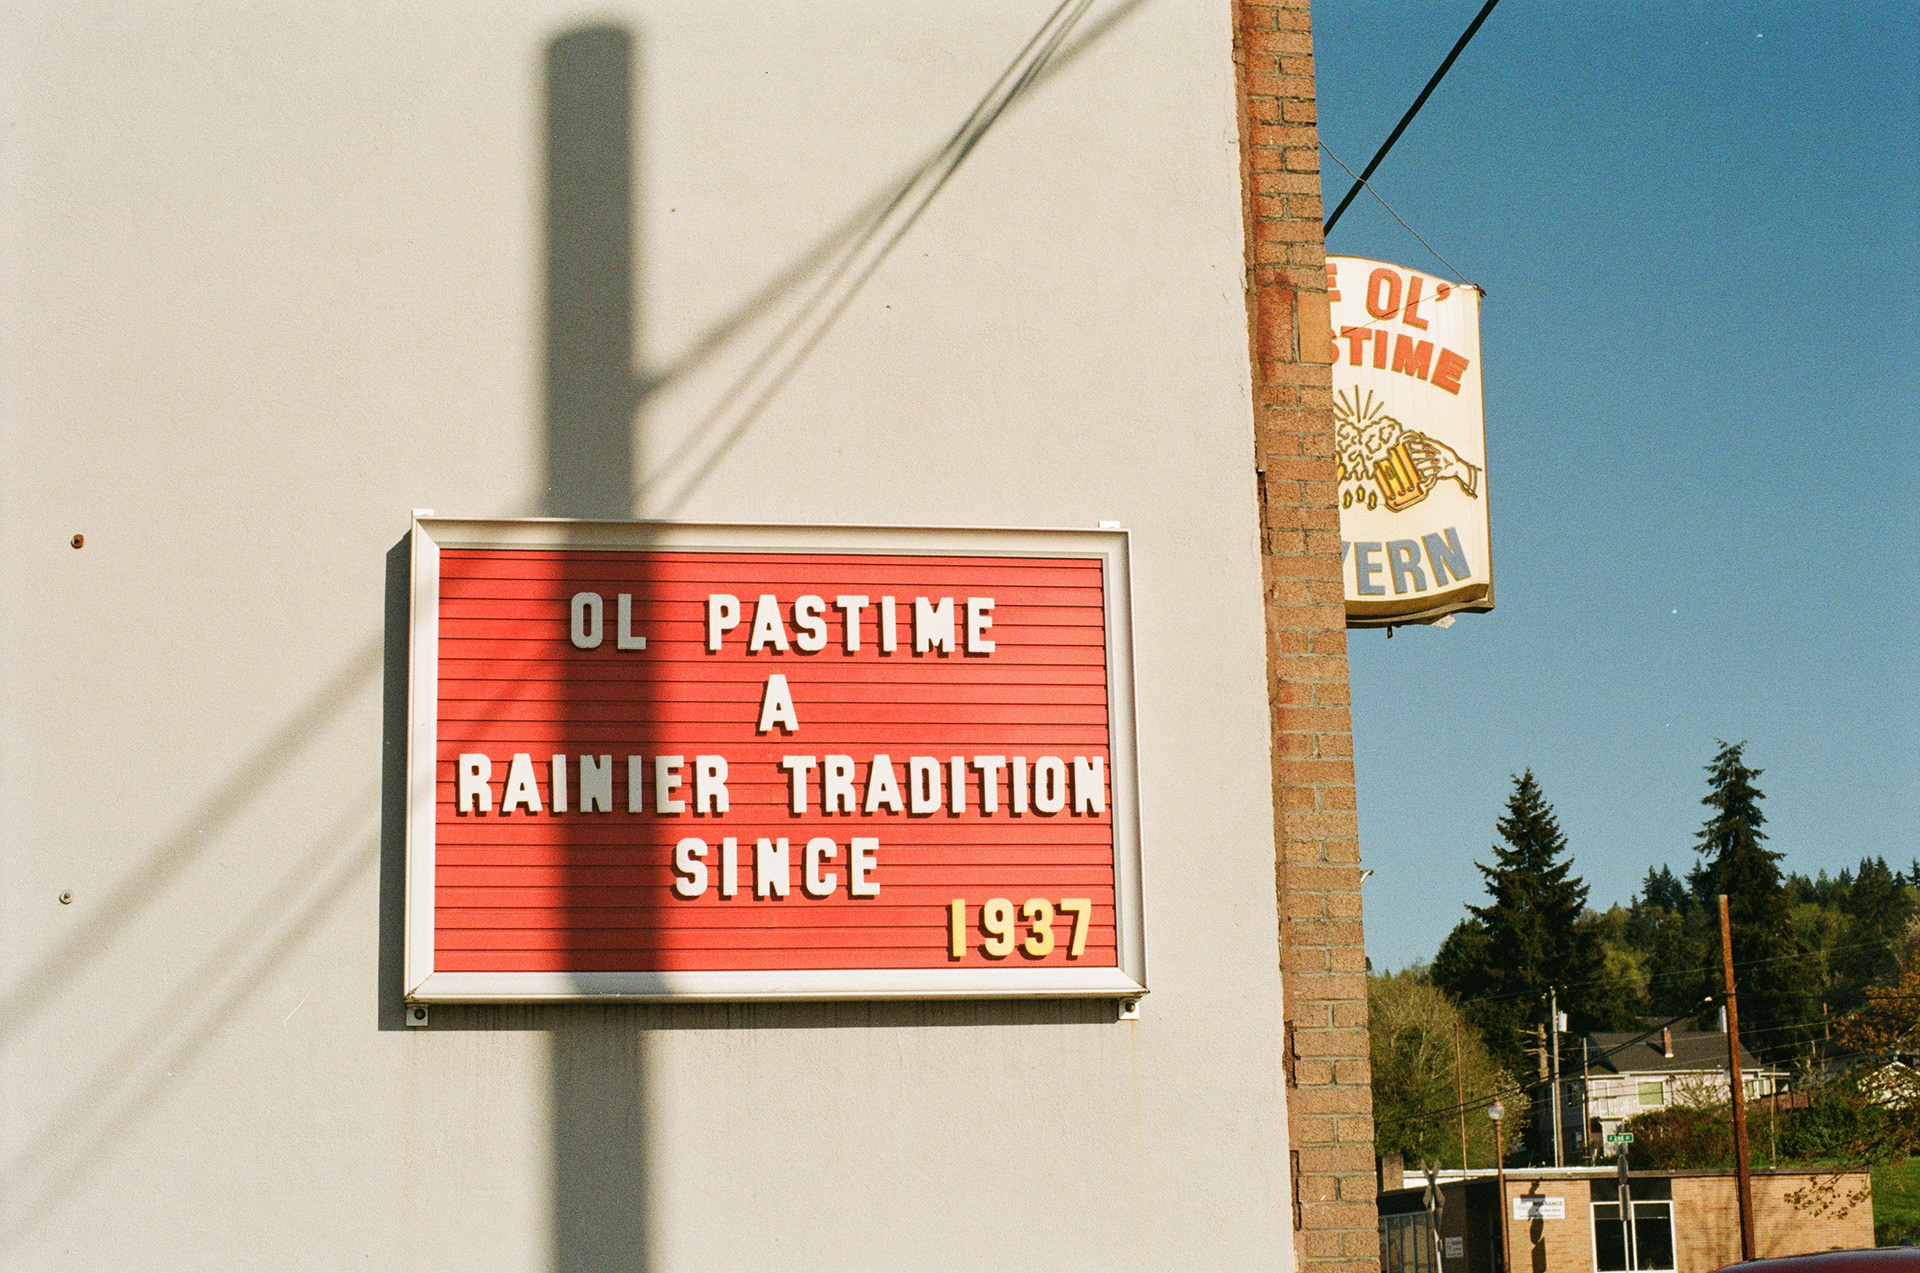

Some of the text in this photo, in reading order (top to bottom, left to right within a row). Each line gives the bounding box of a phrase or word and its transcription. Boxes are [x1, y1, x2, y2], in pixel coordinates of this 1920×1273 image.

[1332, 326, 1470, 396] TIME
[1342, 526, 1472, 596] ERN
[570, 592, 996, 654] OL PASTIME
[757, 674, 799, 732] A
[458, 752, 1106, 814] RAINIER TRADITION
[674, 836, 881, 897] SINCE
[950, 898, 1092, 958] 1937
